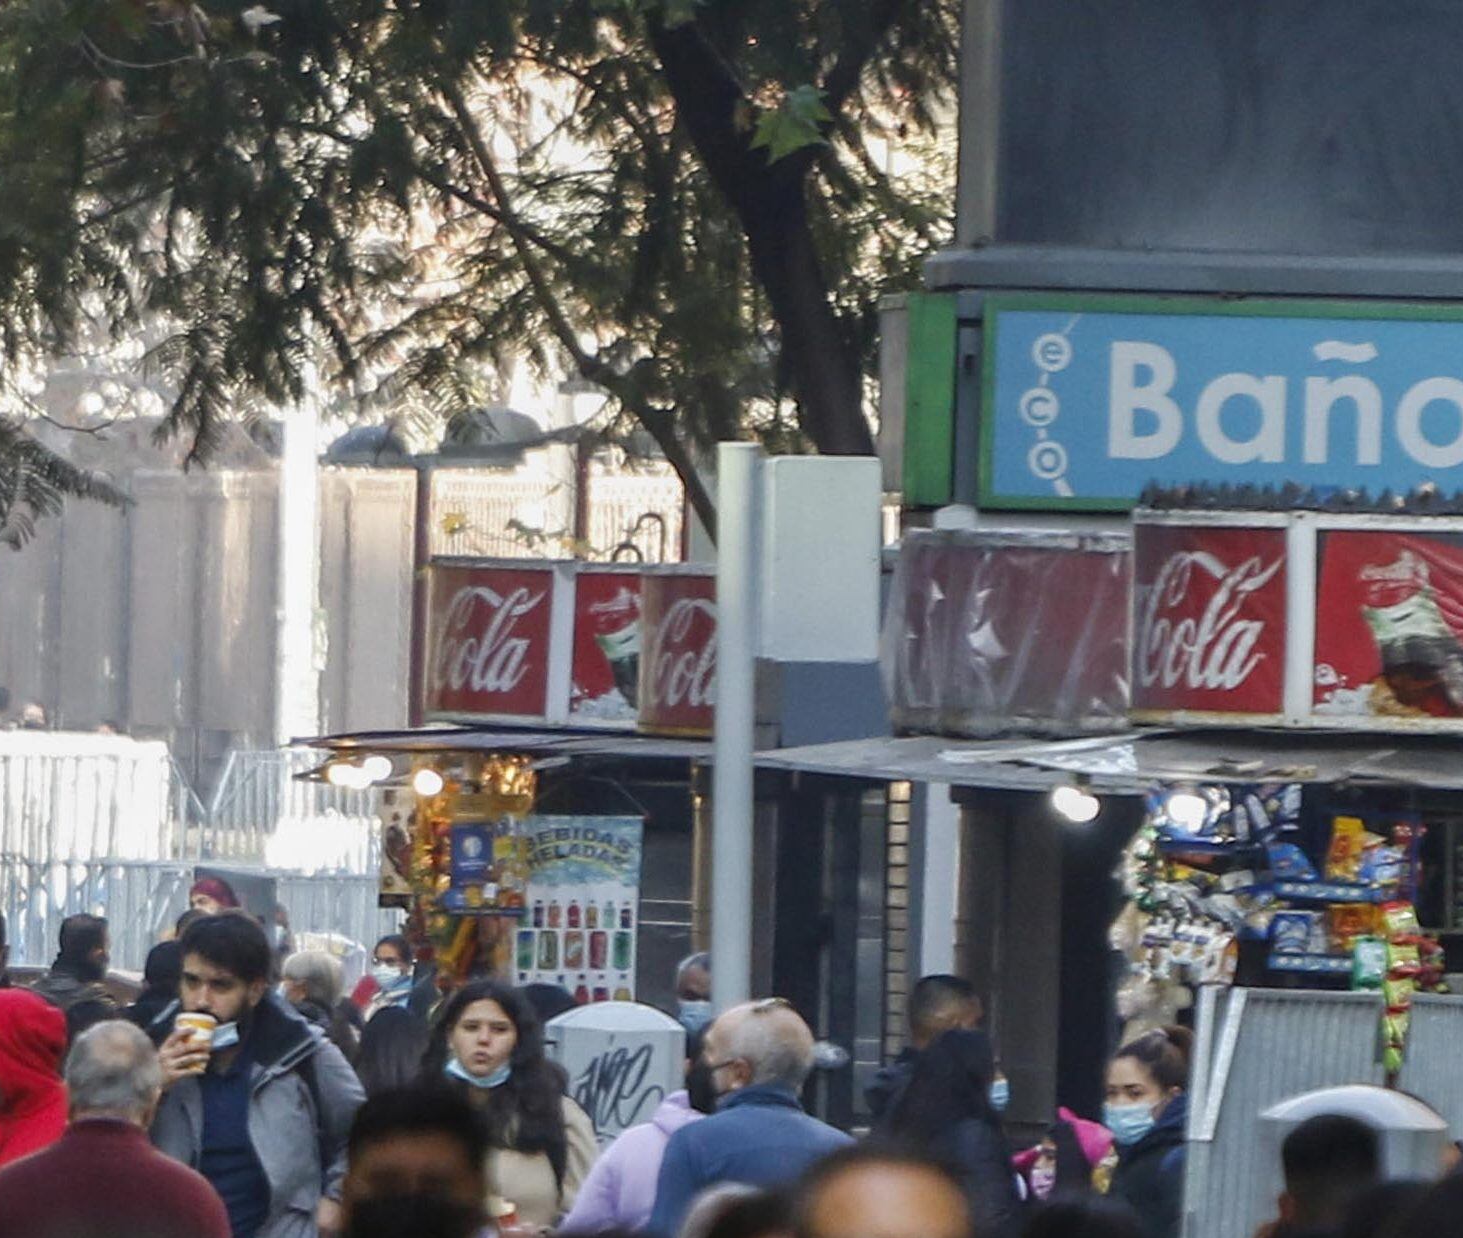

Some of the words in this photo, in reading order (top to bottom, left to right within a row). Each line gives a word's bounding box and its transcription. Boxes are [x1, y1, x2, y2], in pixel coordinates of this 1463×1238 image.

[648, 598, 717, 707] Col
[1140, 550, 1286, 690] Cola
[525, 826, 633, 855] BEBIDAS
